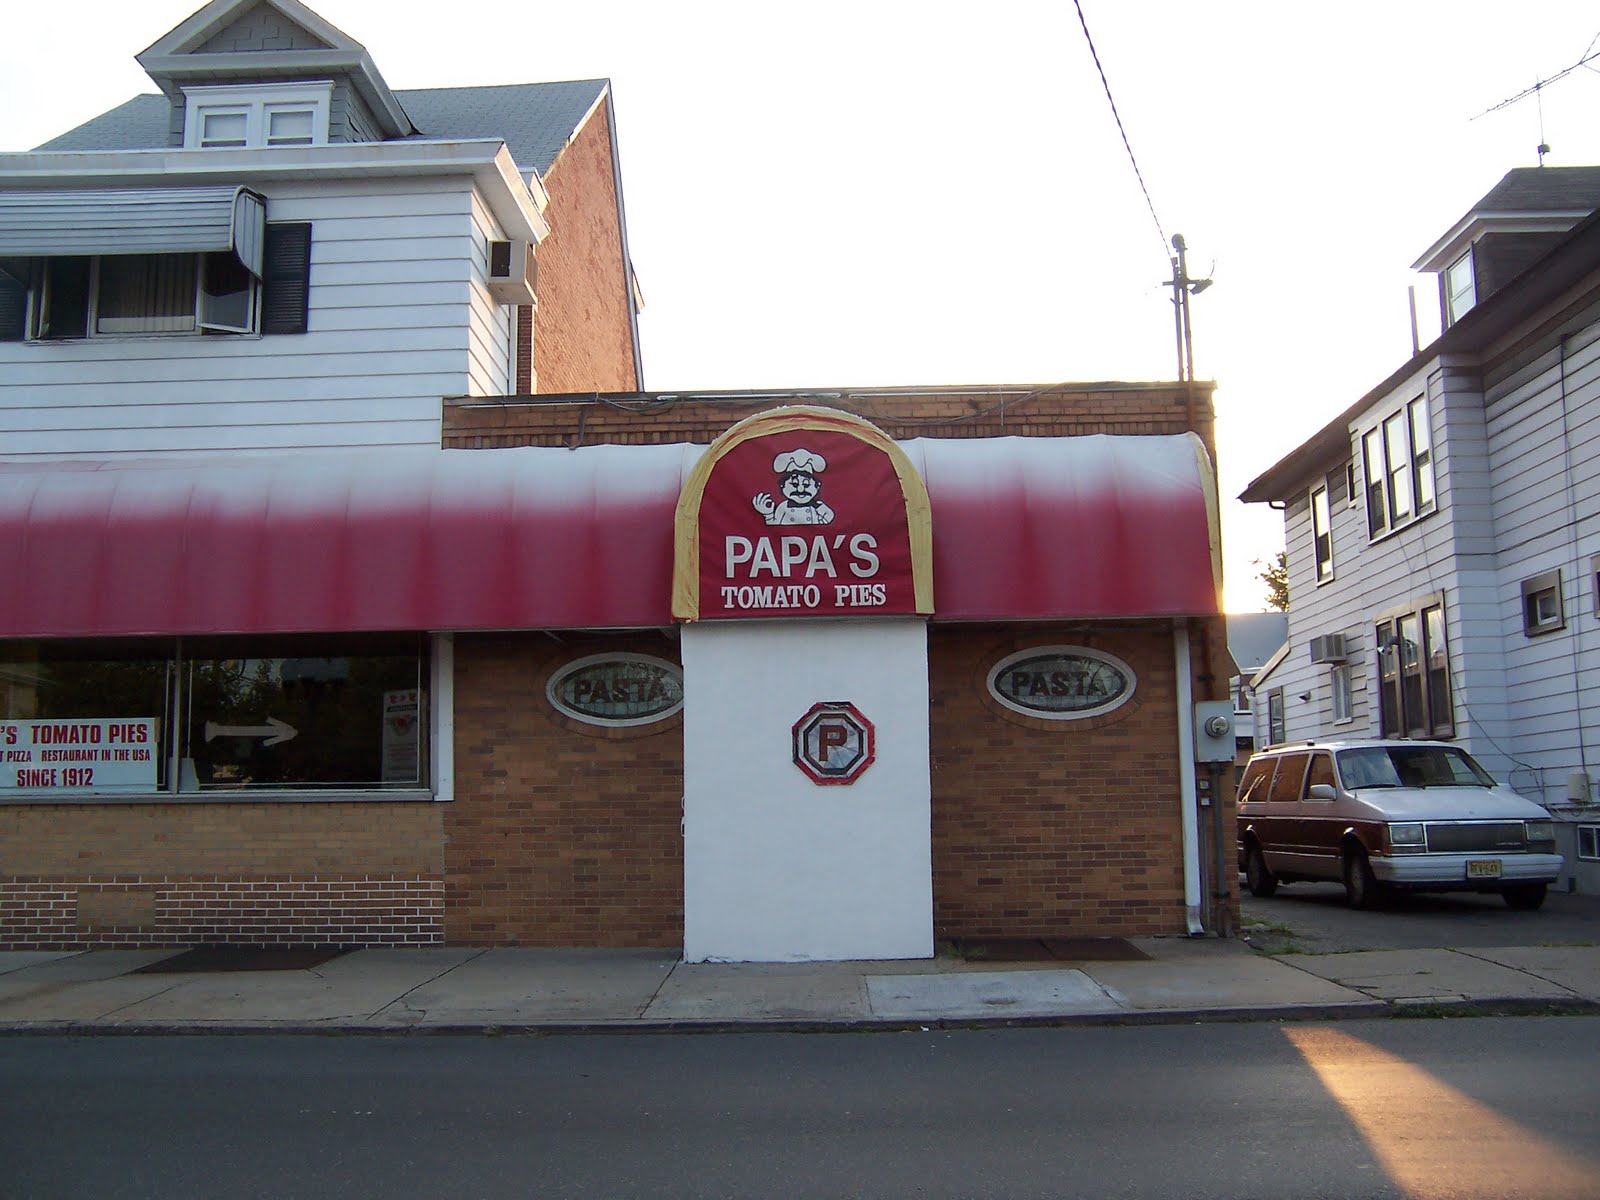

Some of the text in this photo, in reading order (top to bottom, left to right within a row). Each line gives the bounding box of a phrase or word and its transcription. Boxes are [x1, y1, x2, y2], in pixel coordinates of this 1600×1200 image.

[725, 533, 880, 578] PAPA'S
[721, 583, 887, 609] TOMATO PIES
[573, 678, 672, 704] PASTA
[1012, 671, 1109, 697] PASTA
[31, 725, 101, 744] TOMATO
[109, 724, 148, 743] PIES
[6, 750, 32, 763] PIZZA
[41, 749, 98, 762] RESTAURANT
[101, 749, 111, 761] IN
[114, 749, 130, 761] THE
[132, 748, 151, 761] USA
[17, 768, 93, 786] SINCE 1912
